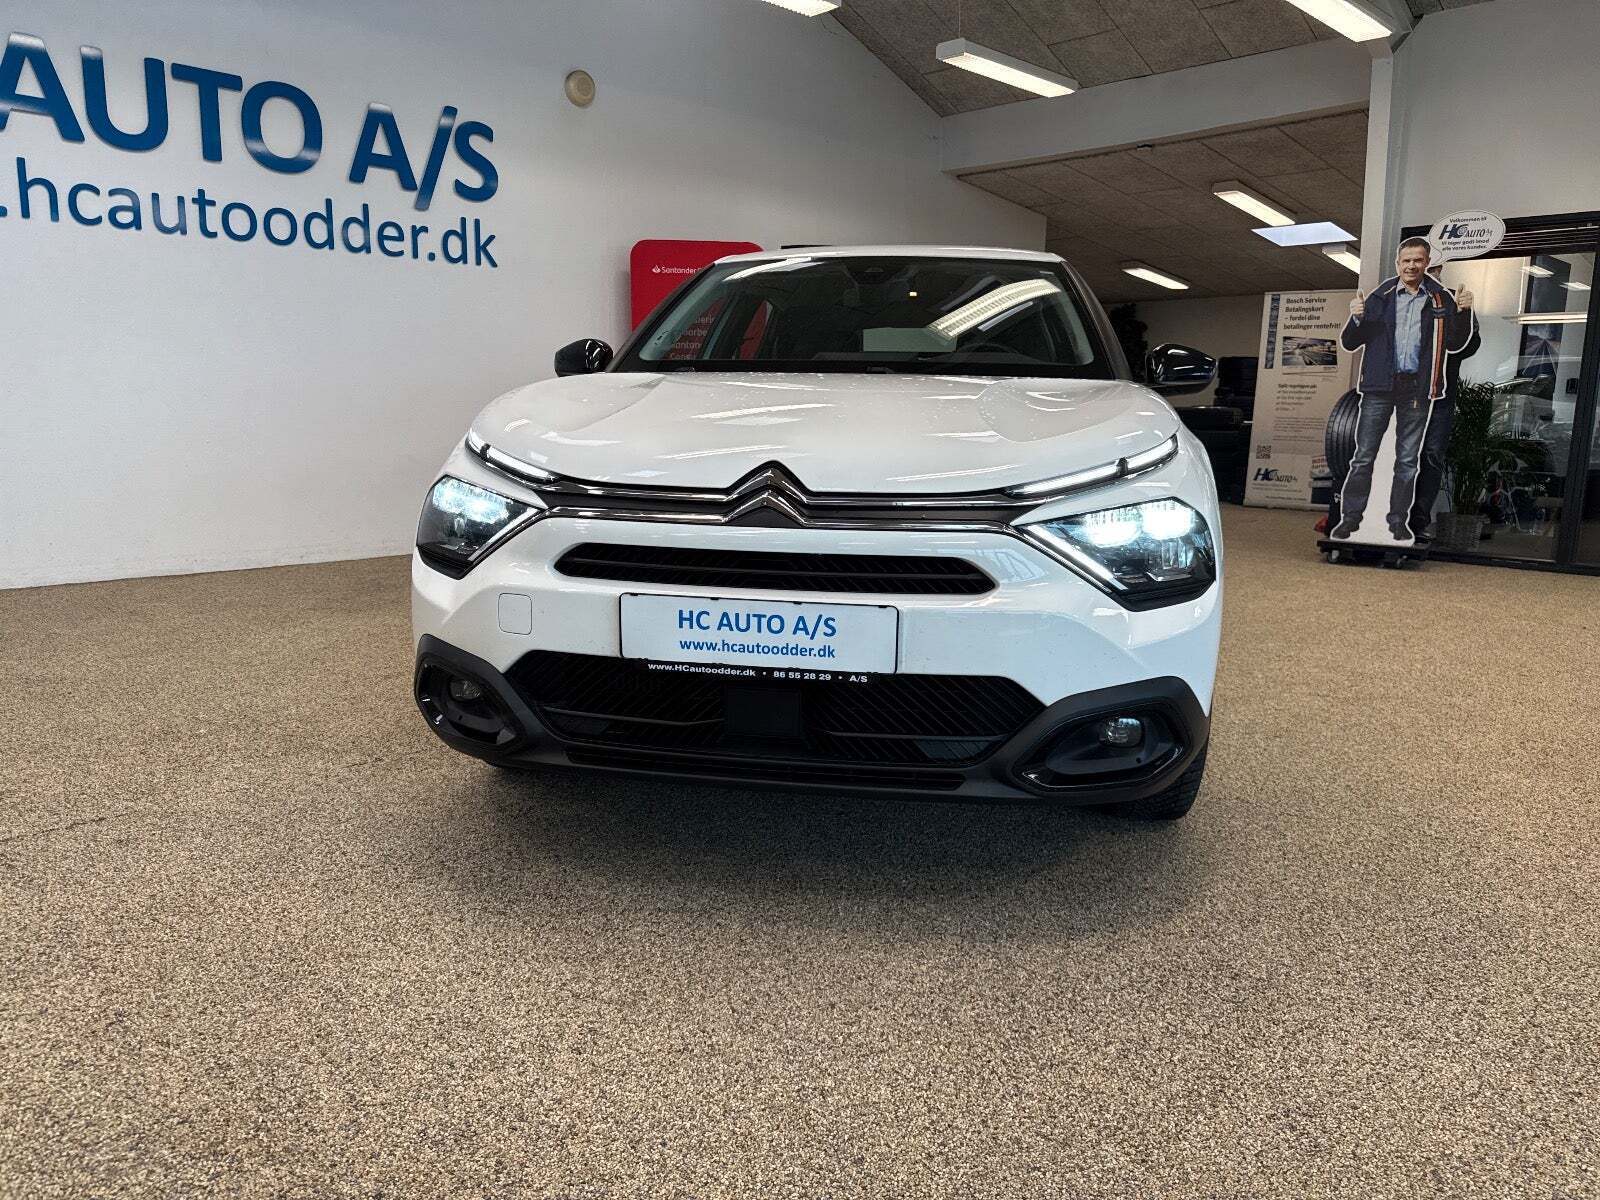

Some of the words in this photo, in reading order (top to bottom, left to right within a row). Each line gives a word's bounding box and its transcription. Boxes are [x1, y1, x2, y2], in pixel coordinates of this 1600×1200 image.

[0, 31, 323, 174] AUTO
[348, 102, 499, 211] A/S
[1464, 228, 1486, 238] AUTO
[661, 266, 696, 275] Santander
[678, 608, 711, 631] HC
[717, 611, 786, 635] AUTO
[792, 613, 838, 640] A/S
[679, 639, 836, 659] www.hcautoodder.dk
[648, 662, 757, 677] www.HCautoodder.dk
[773, 670, 787, 679] 86
[788, 671, 801, 680] 55
[803, 672, 817, 680] 28
[818, 673, 832, 681] 29
[849, 674, 868, 683] A/S
